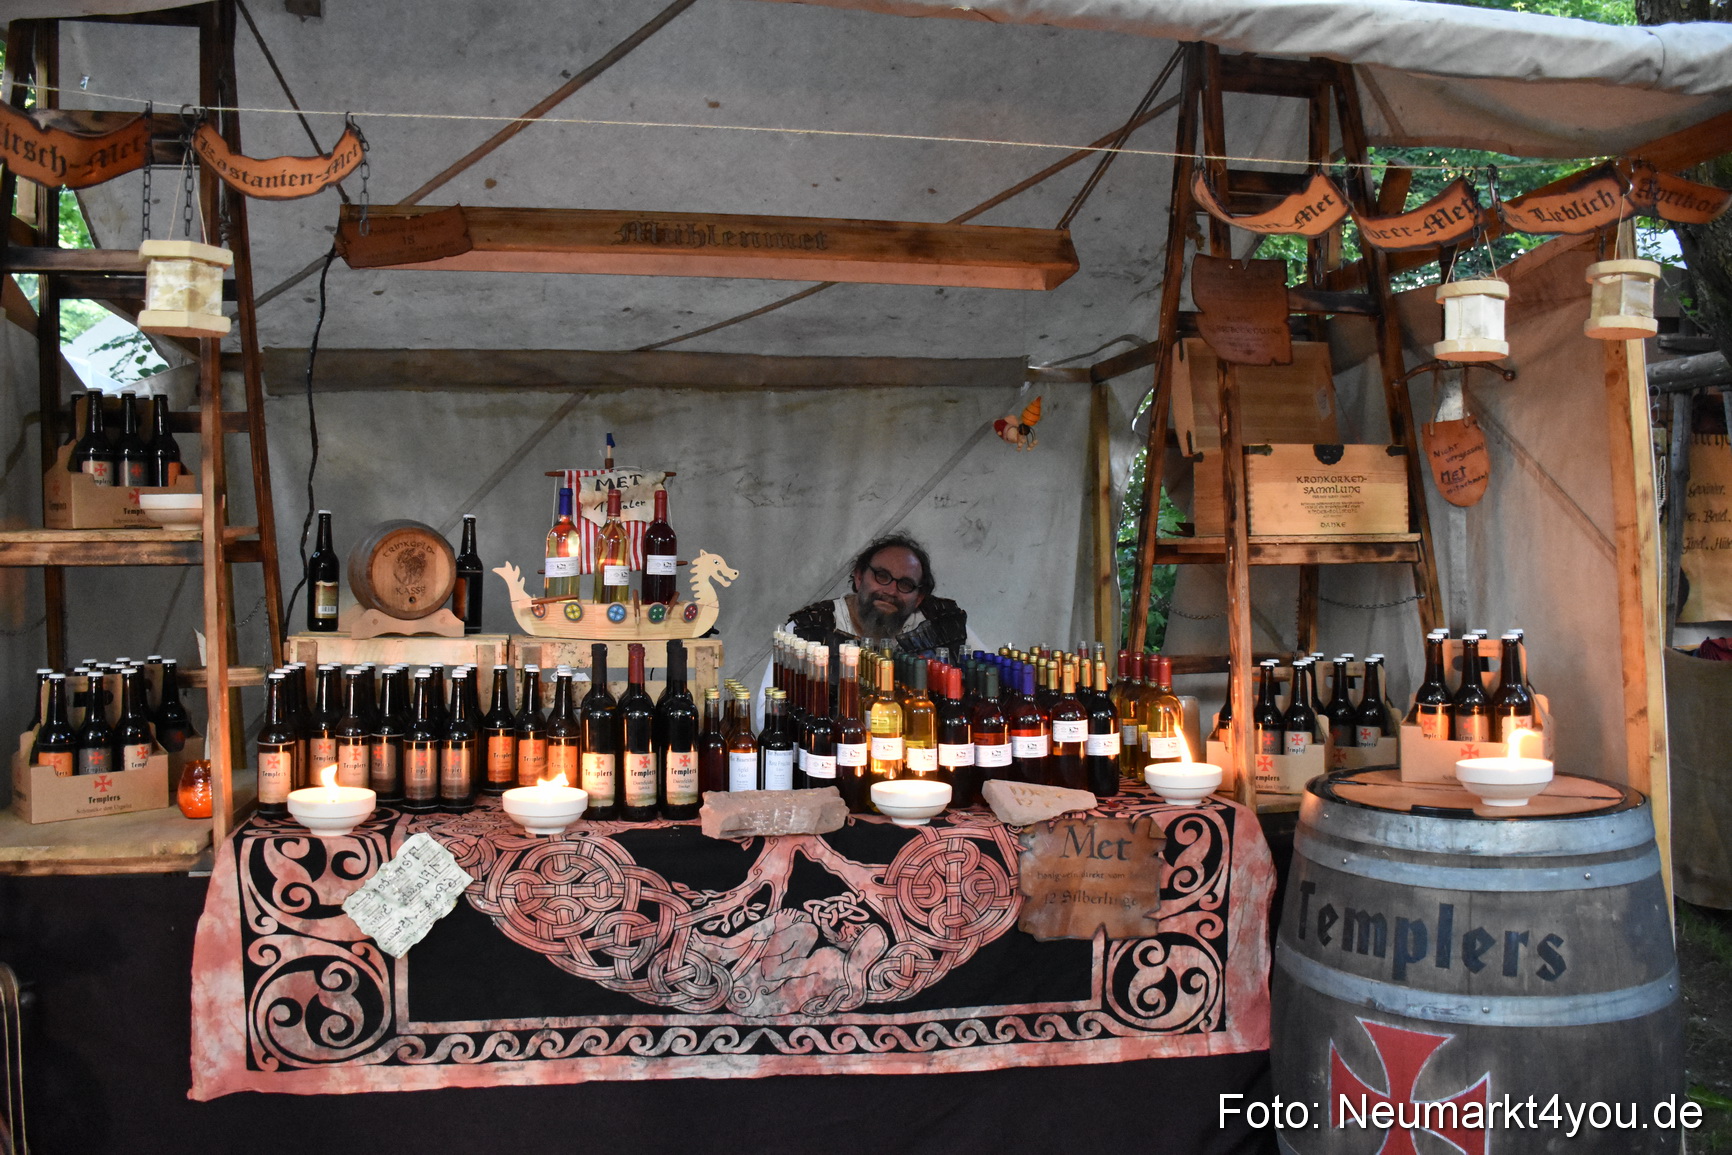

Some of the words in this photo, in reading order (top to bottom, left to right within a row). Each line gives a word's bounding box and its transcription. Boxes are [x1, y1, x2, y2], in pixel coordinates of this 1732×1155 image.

[0, 122, 142, 178] irsch-Met
[1527, 189, 1616, 223] Lieblich
[595, 474, 643, 491] MET
[1296, 475, 1368, 484] KRONKORKEN-
[1303, 485, 1361, 495] SAMMLUNG
[630, 768, 656, 778] Templers
[671, 767, 697, 777] Templers
[1255, 775, 1280, 783] emplers
[88, 795, 121, 804] Templers
[1059, 825, 1132, 861] Met
[1298, 881, 1567, 982] Templers
